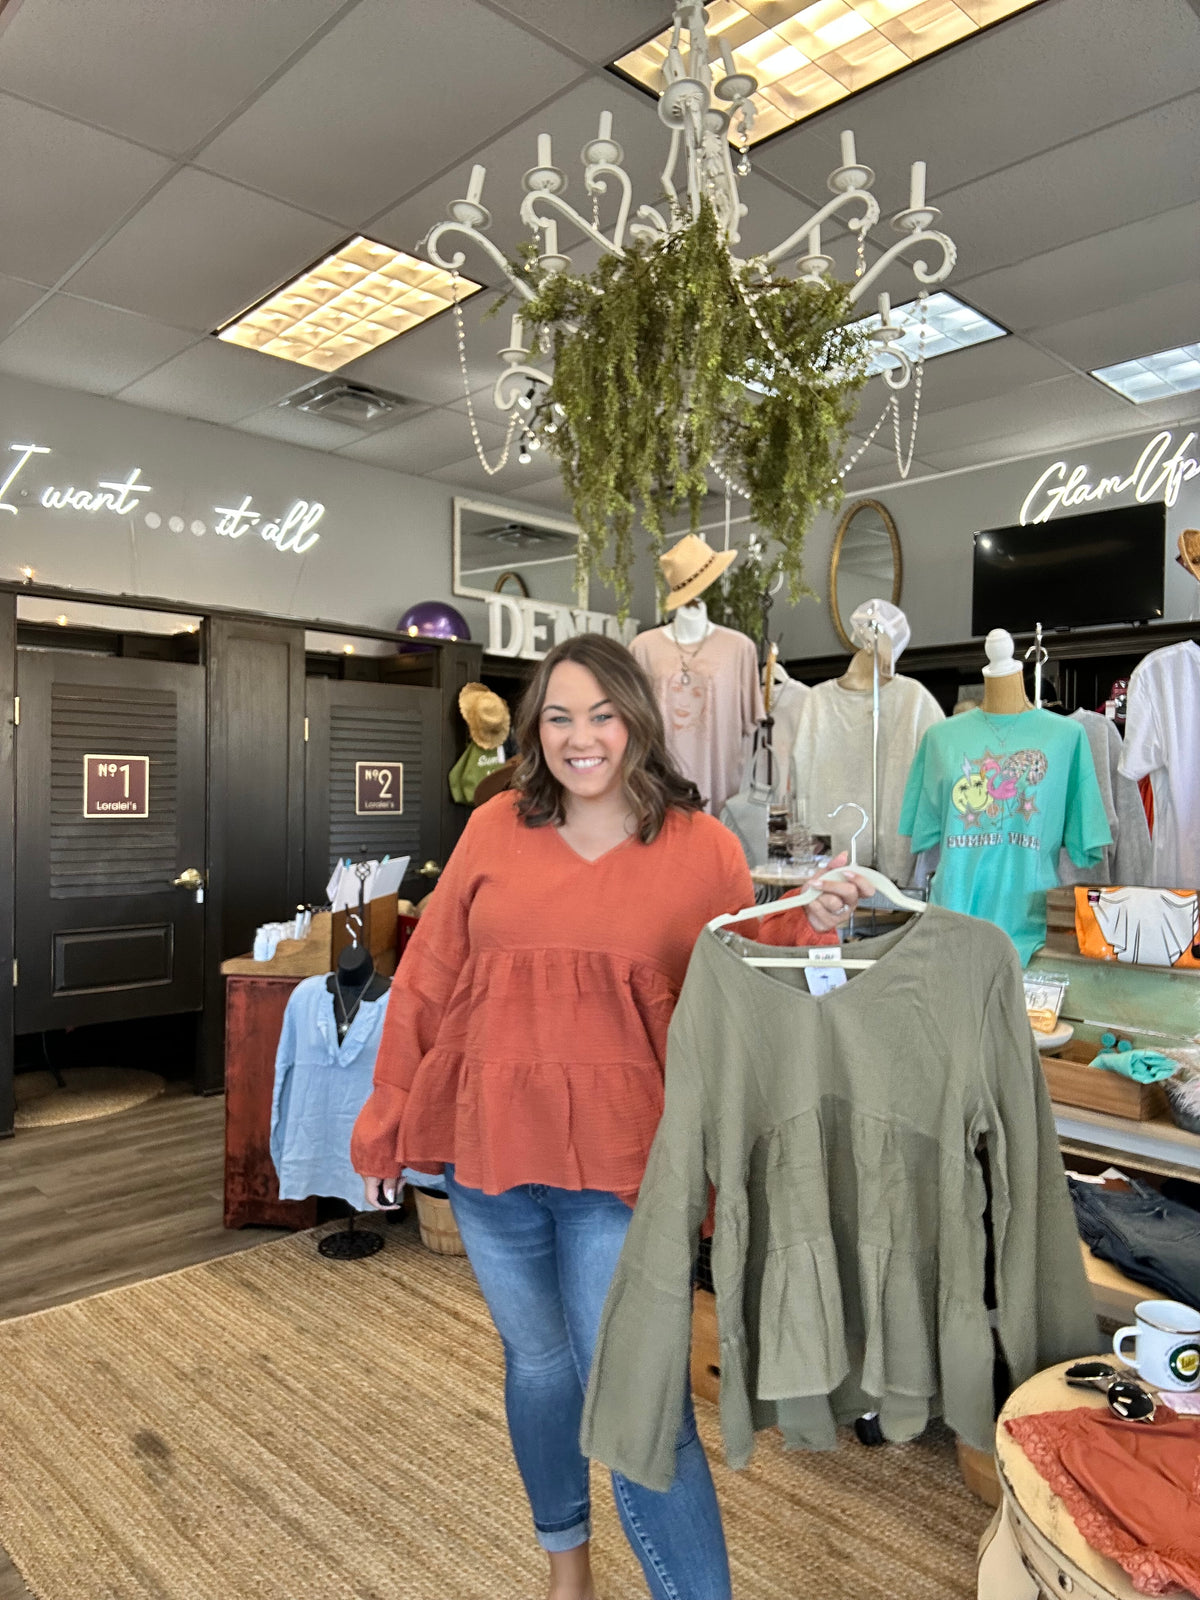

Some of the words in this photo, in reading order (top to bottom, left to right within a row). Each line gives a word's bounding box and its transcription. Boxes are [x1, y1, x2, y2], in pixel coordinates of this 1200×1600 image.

[41, 467, 152, 515] want
[214, 495, 261, 539] it
[261, 499, 325, 554] all
